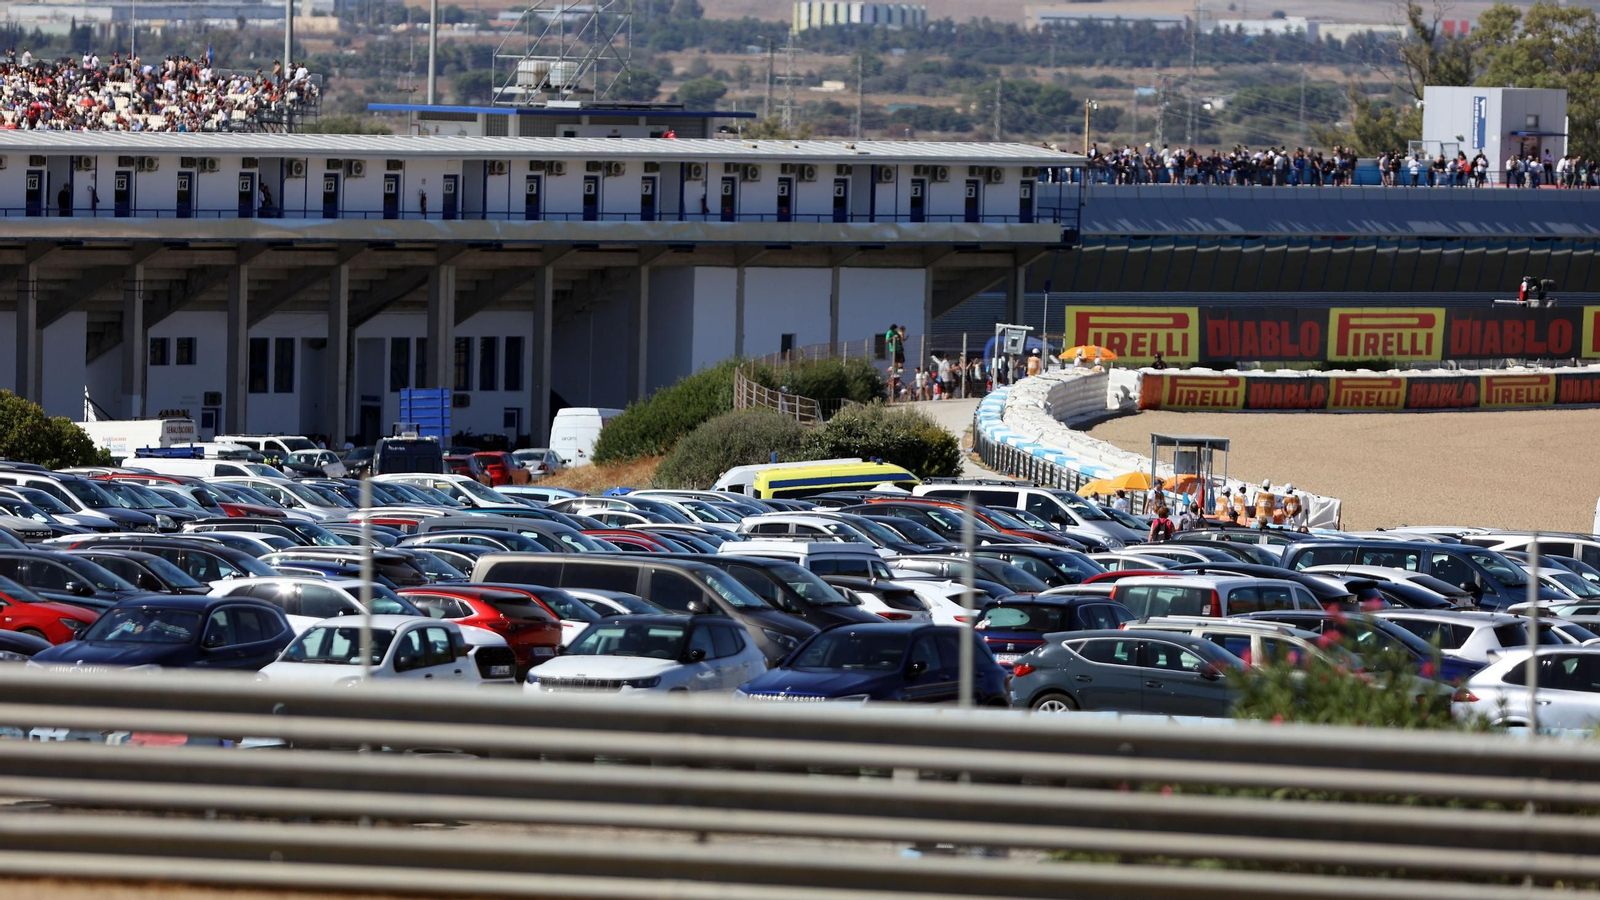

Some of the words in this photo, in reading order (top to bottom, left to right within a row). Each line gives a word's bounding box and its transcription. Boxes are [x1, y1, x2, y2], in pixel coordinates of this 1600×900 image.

[1480, 98, 1485, 119] 1
[117, 180, 124, 188] 15
[1075, 312, 1189, 357] PIRELLI
[1206, 311, 1320, 357] DIABLO
[1336, 313, 1436, 357] PIRELLI
[1450, 313, 1573, 355] DIABLO
[1167, 376, 1239, 406] PIRELLI
[1250, 381, 1325, 409] DIABLO
[1332, 378, 1402, 406] PIRELLI
[1410, 381, 1476, 406] DIABLO
[1485, 374, 1550, 404] PIRELLI
